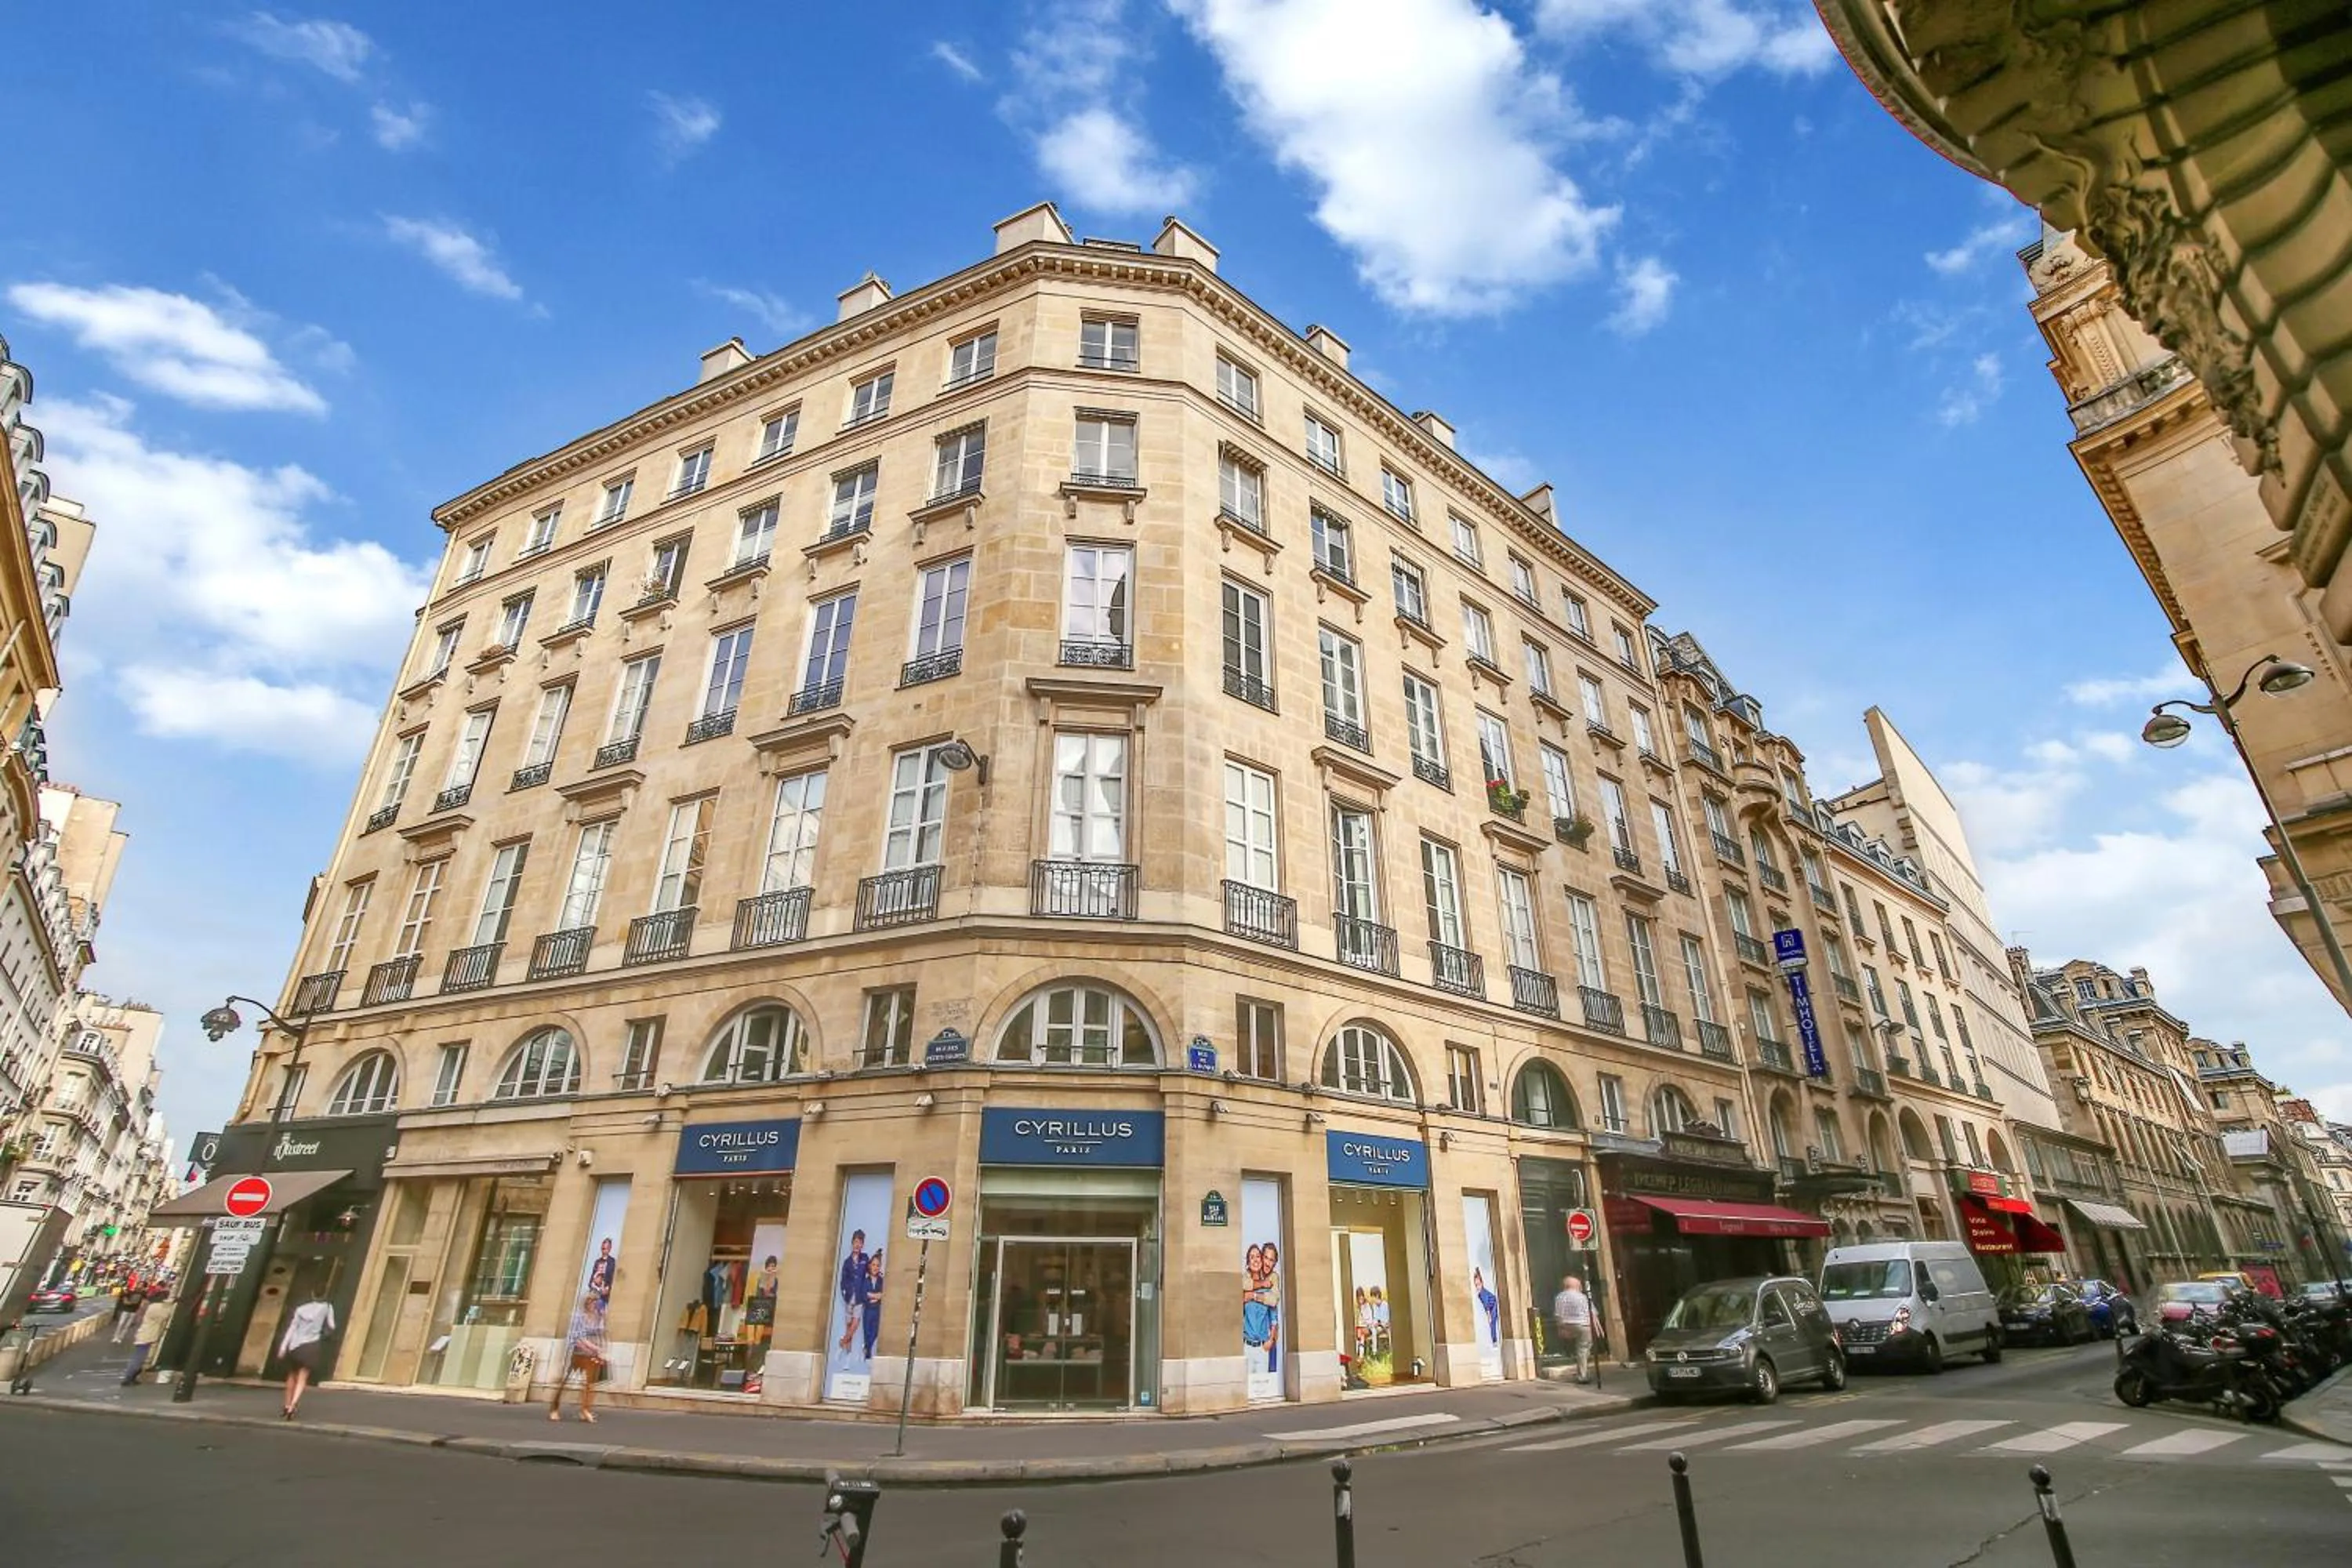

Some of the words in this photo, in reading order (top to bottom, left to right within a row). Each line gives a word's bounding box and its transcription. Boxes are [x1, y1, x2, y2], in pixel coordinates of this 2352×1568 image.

[1792, 975, 1820, 1064] TIMHOTEL
[1014, 1120, 1134, 1138] CYRILLUS
[699, 1131, 779, 1148] CYRILLUS
[1055, 1145, 1091, 1155] PARIS
[1342, 1142, 1411, 1162] CYRILLUS
